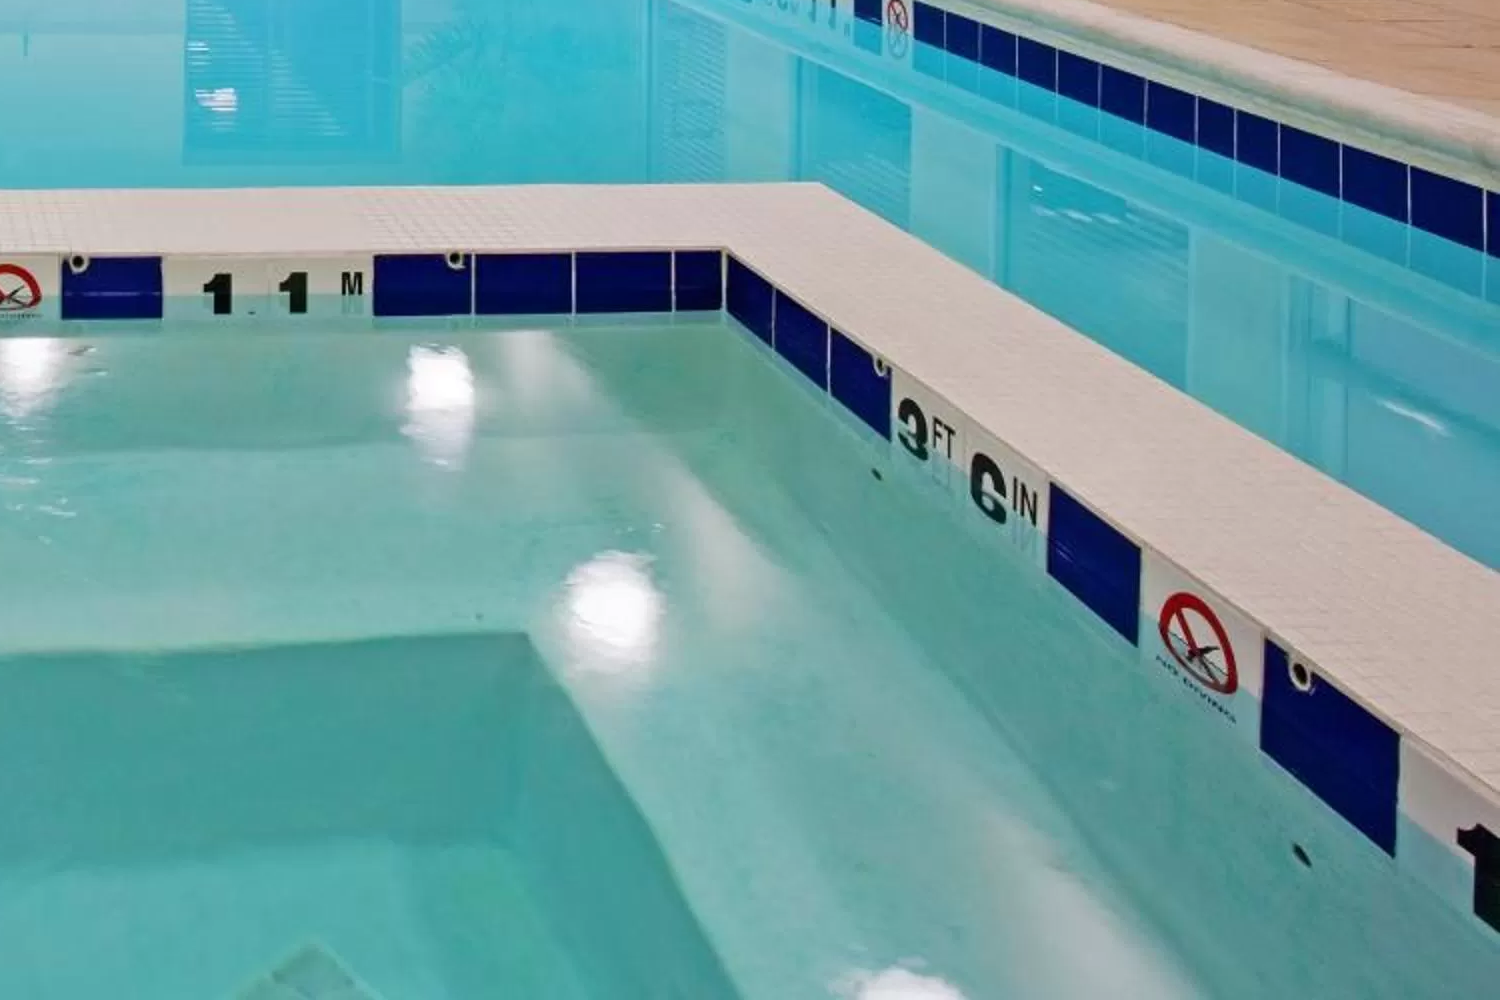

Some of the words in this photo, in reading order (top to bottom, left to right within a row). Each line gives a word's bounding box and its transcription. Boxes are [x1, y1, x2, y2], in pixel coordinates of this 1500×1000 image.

[342, 271, 363, 296] M
[898, 397, 929, 461] 3
[932, 416, 956, 460] FT
[970, 452, 1007, 525] 6
[1012, 475, 1037, 527] IN
